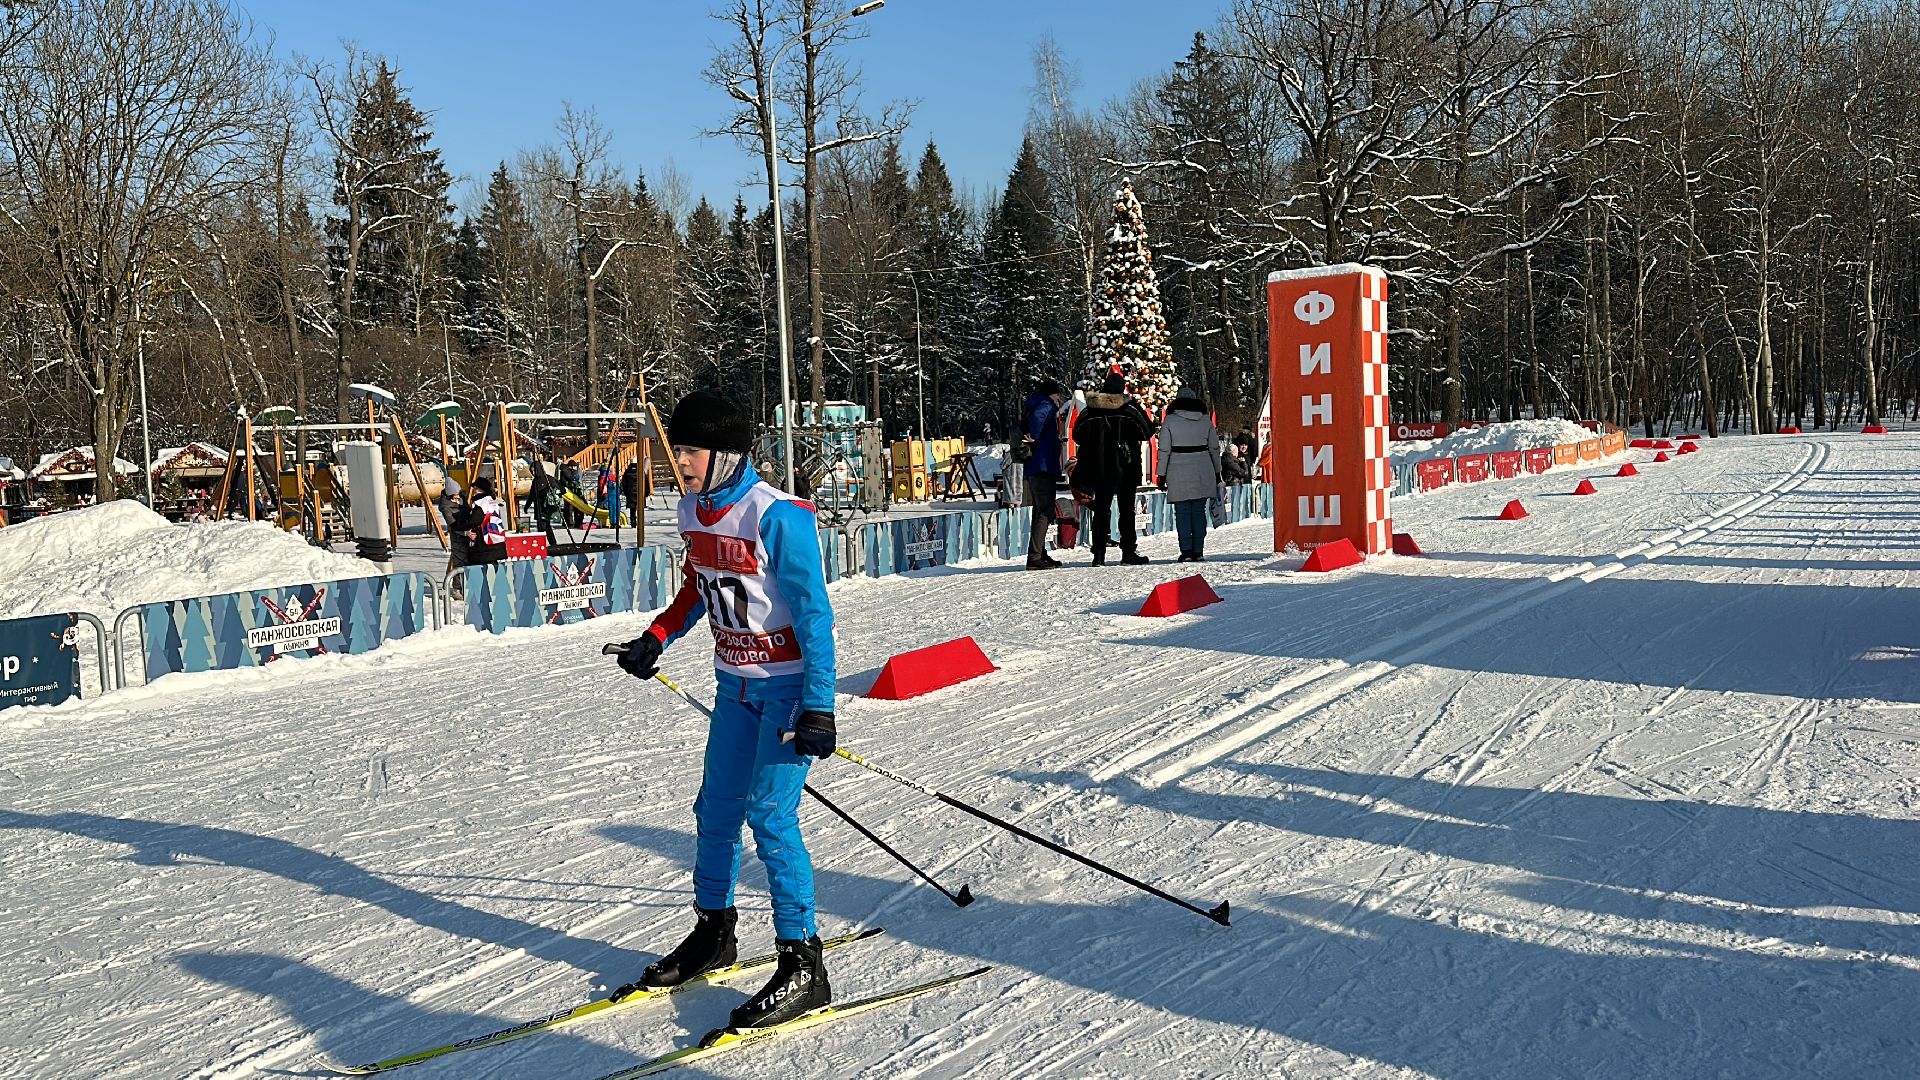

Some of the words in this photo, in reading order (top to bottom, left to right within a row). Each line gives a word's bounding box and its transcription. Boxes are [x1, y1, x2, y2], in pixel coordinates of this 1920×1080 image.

[1294, 290, 1341, 526] ФИНИШ
[541, 584, 604, 603] МАНЖОСОВСКАЯ
[251, 619, 338, 644] МАНЖОСОВСКАЯ
[283, 639, 310, 651] ЛЫЖНЯ
[758, 981, 799, 1011] TISA
